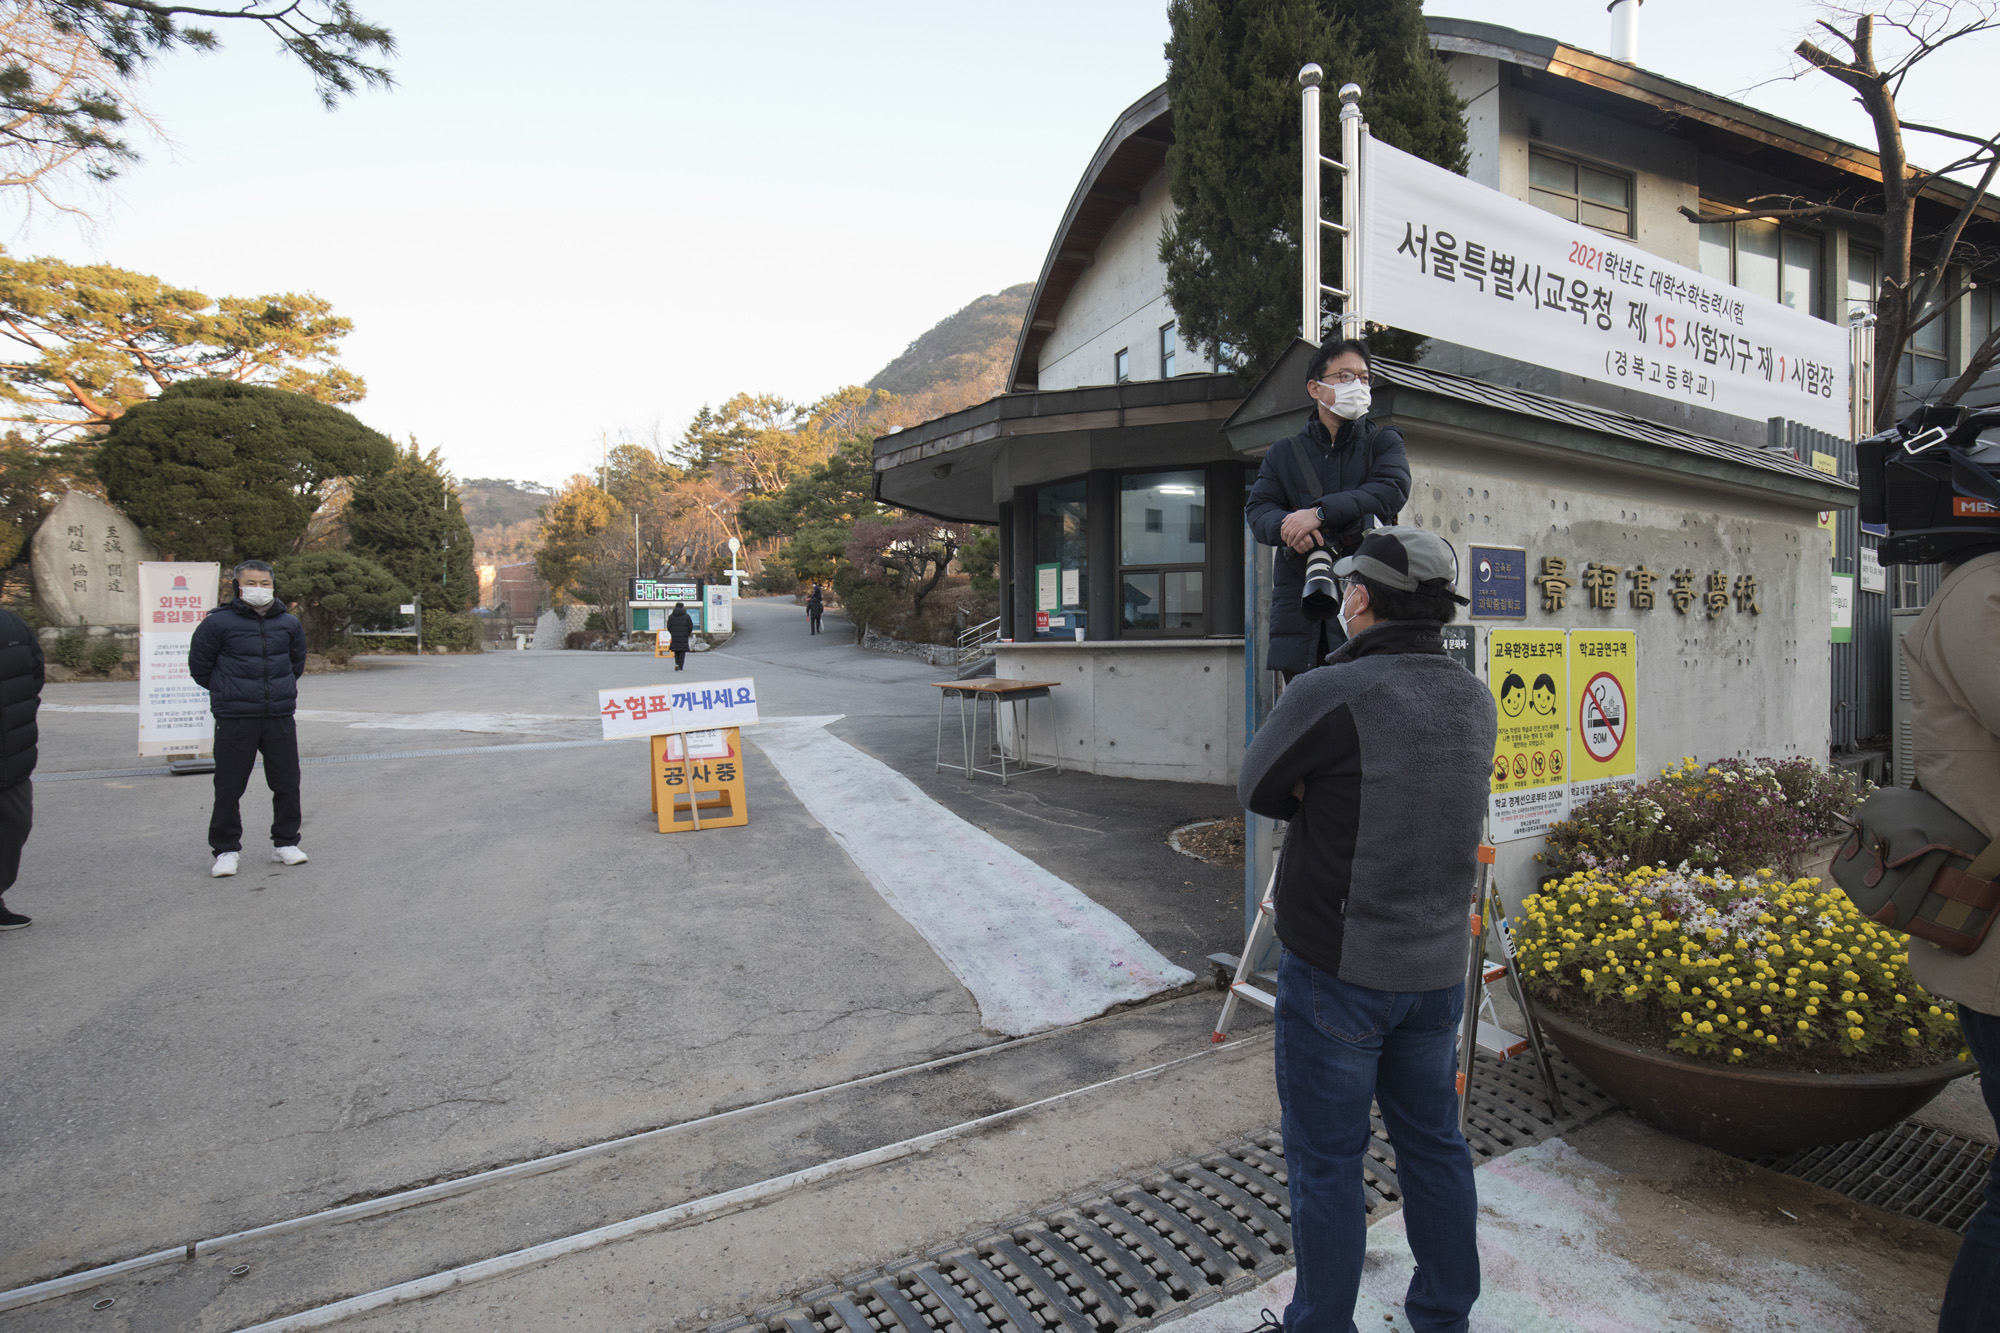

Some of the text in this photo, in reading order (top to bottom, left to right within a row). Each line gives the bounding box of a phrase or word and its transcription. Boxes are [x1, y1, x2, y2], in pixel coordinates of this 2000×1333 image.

[1568, 240, 1744, 326] 2021학년도 대학수학능력시험
[1397, 221, 1835, 400] 서울특별시교육청 제 15 시험지구 제 1 시험장
[1605, 350, 1716, 402] (경복고등학교)
[1961, 501, 2000, 513] MB
[1494, 562, 1512, 573] 교육부
[159, 596, 202, 609] 외부인
[1479, 597, 1520, 611] 과학중점학교
[1494, 641, 1563, 659] 교육환경보호구역
[1579, 642, 1627, 658] 학교금연구역
[601, 686, 755, 721] 수험표 꺼내세요
[1593, 732, 1607, 744] 50M
[1495, 798, 1507, 809] 학교
[1508, 791, 1547, 808] 경계선으로부터
[1548, 790, 1563, 800] 200M
[1571, 787, 1580, 796] 학교
[1581, 786, 1584, 795] 내
[1507, 934, 1516, 956] YTN
